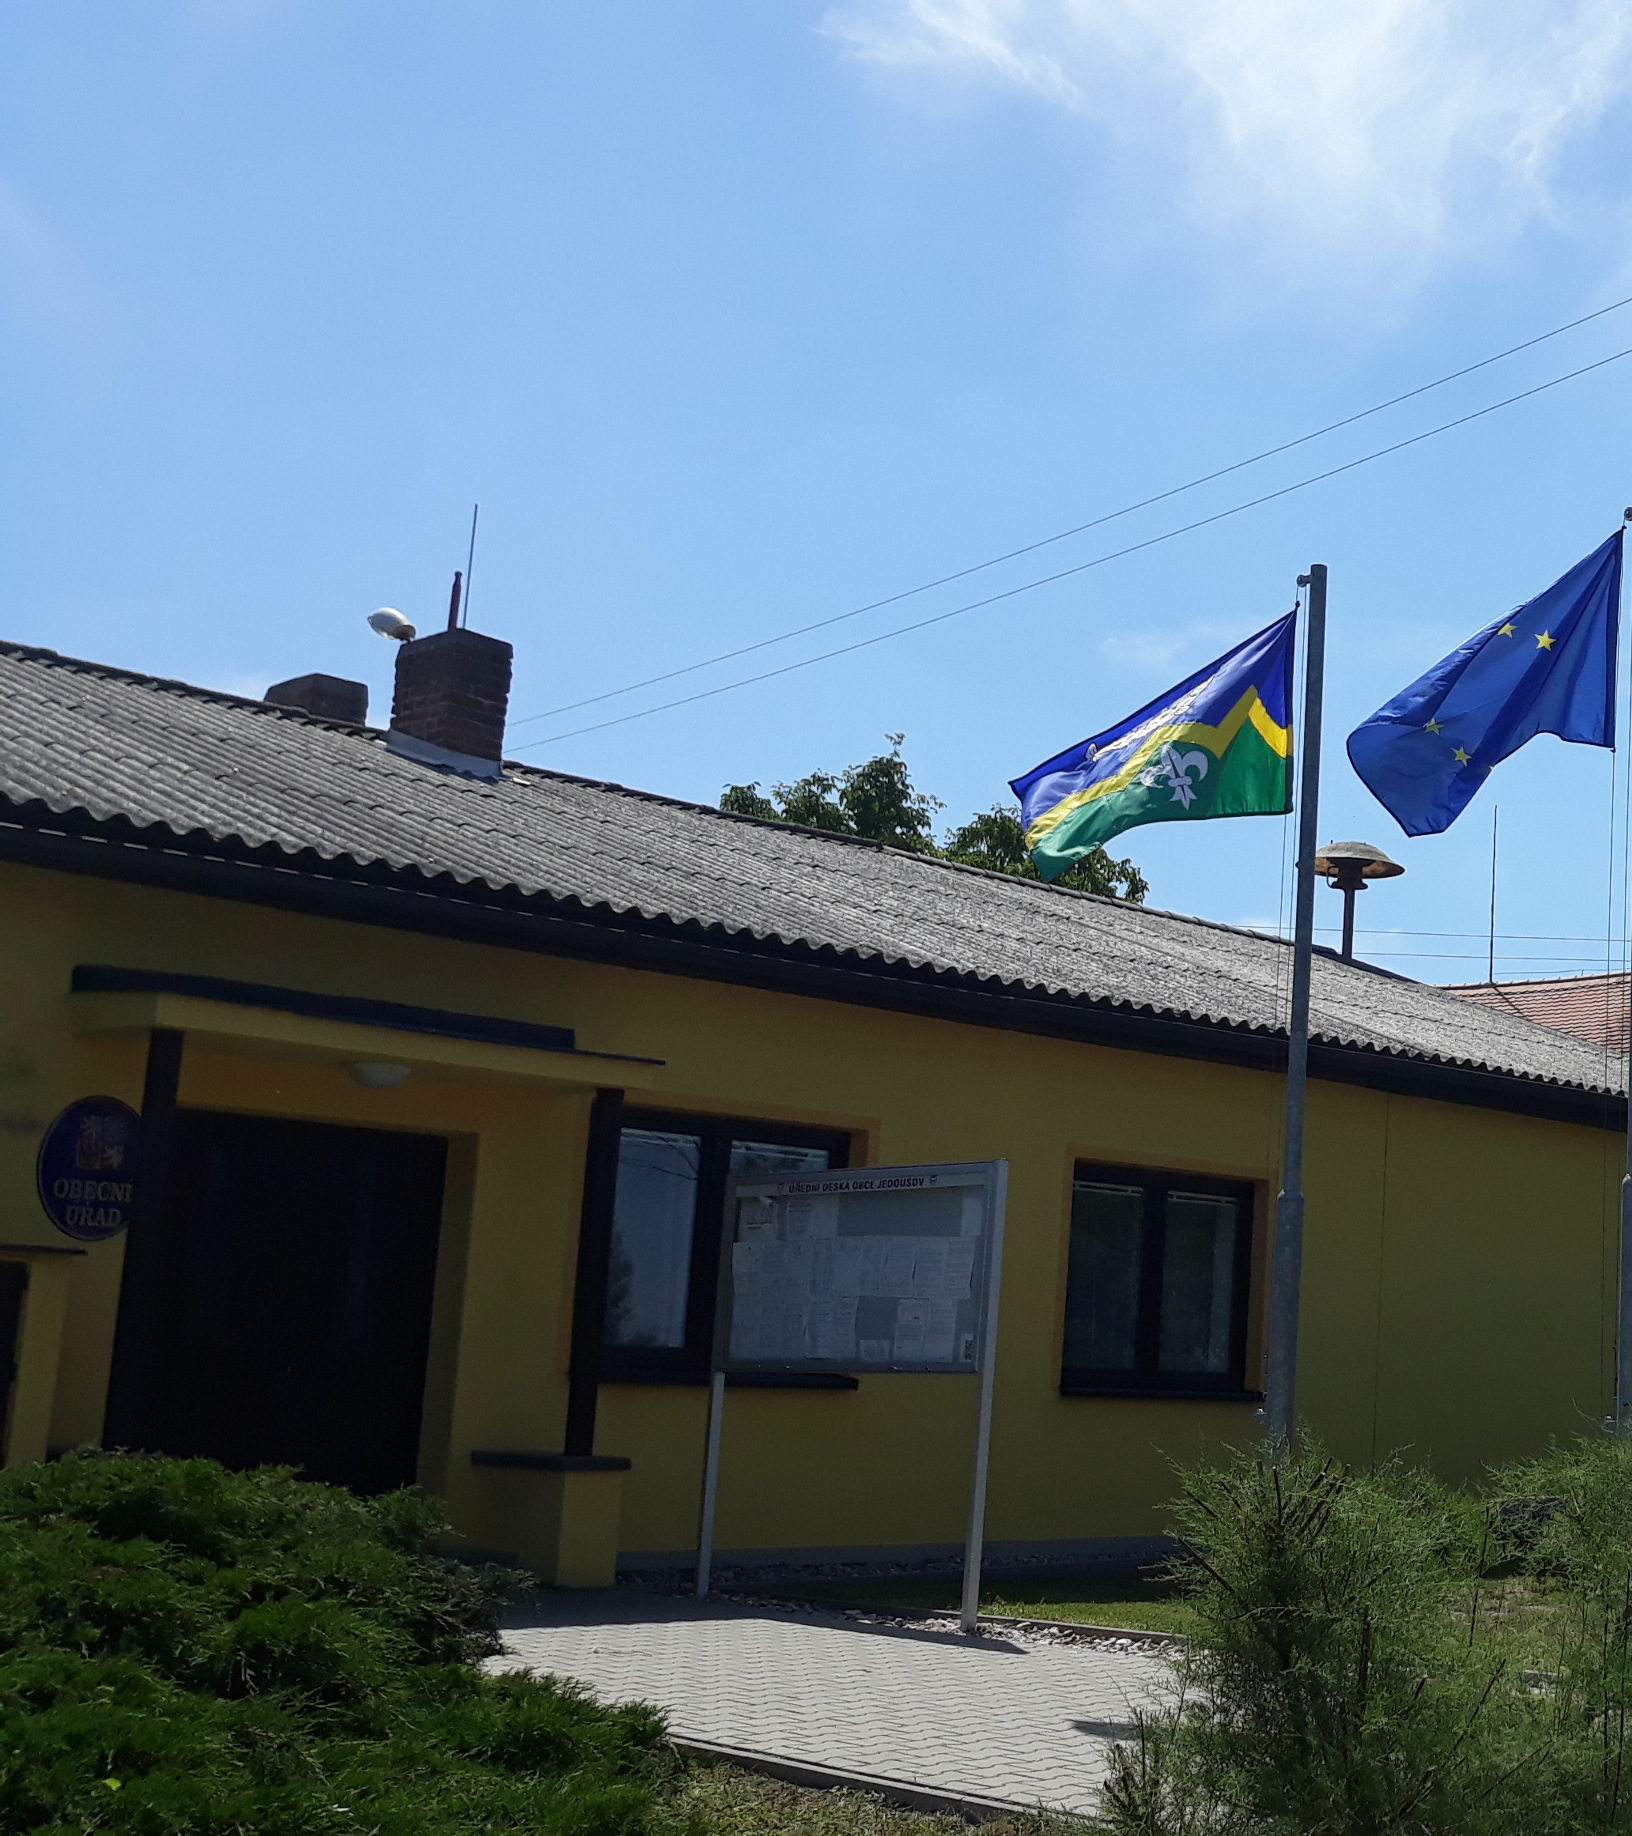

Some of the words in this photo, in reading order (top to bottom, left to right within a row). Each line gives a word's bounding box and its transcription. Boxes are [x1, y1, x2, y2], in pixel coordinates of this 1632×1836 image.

[53, 1178, 133, 1202] OBECNÍ
[822, 1181, 850, 1192] DESKA
[852, 1179, 874, 1190] OBCE
[877, 1177, 925, 1189] JEDOUSOV
